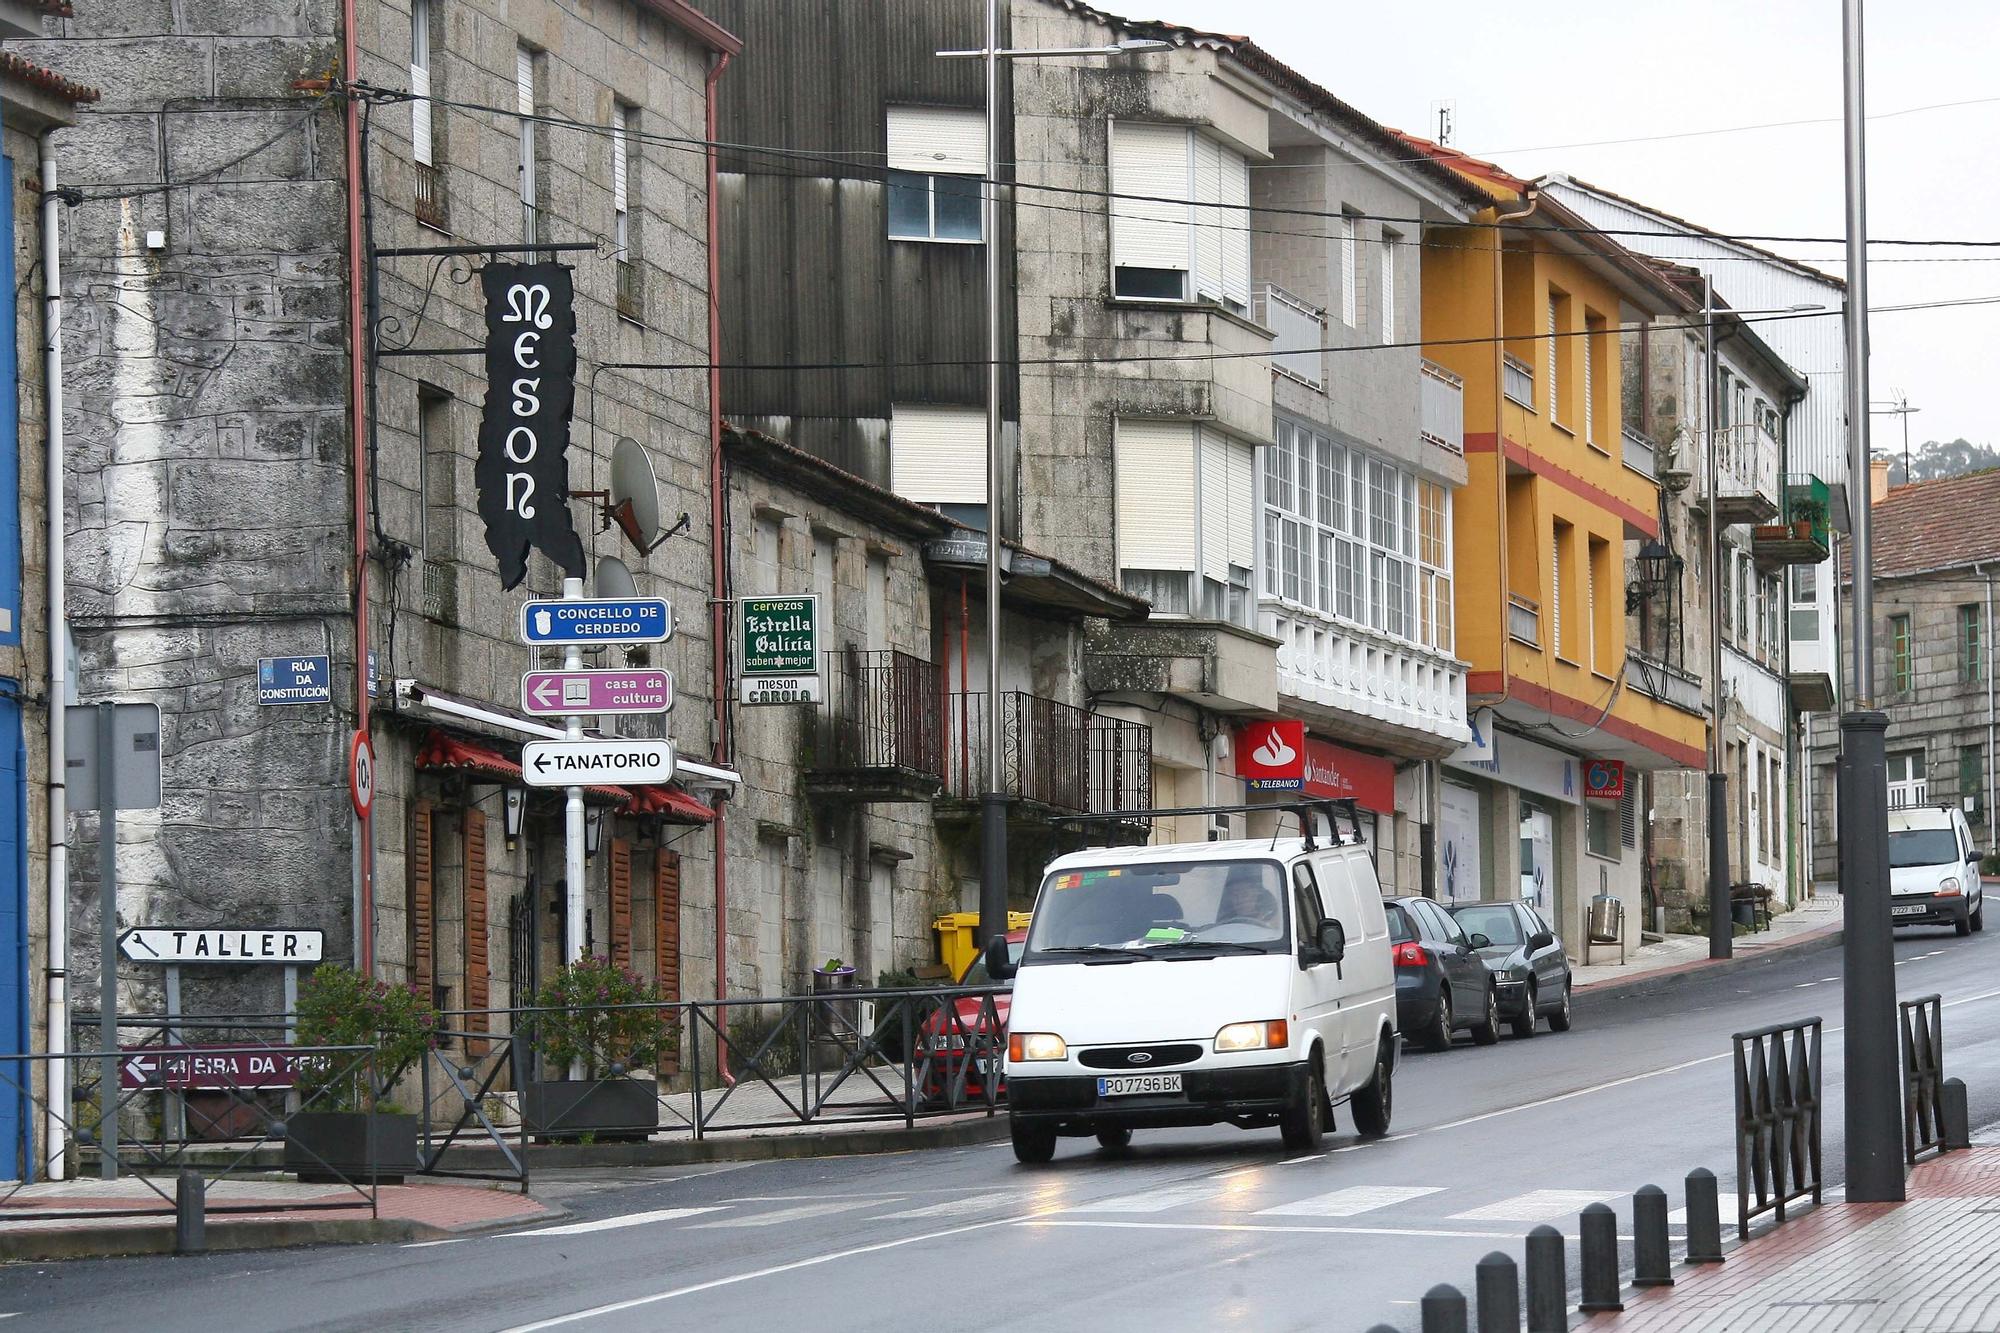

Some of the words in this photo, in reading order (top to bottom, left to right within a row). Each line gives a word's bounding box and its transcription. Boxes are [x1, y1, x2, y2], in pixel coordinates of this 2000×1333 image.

[753, 602, 803, 611] cervezas
[557, 607, 632, 620] CONCELLO
[639, 607, 658, 618] DE
[575, 622, 641, 634] CERDEDO
[745, 615, 812, 634] Estrella
[755, 634, 812, 653] Galicia
[291, 660, 316, 672] RÚA
[746, 655, 774, 666] saben
[785, 655, 812, 667] mejor
[295, 674, 313, 685] DA
[605, 678, 637, 689] casa
[646, 677, 663, 688] da
[757, 679, 798, 690] meson
[260, 684, 329, 699] CONSTITUCIÓN
[613, 692, 663, 704] cultura
[748, 690, 811, 703] CAROLA
[554, 752, 661, 770] TANATORIO
[1311, 757, 1340, 788] Santander
[1260, 779, 1299, 789] TELEBANCO
[172, 932, 298, 957] TALLER
[249, 1056, 277, 1074] DA
[1125, 1078, 1161, 1093] 7796
[1163, 1076, 1181, 1091] BK
